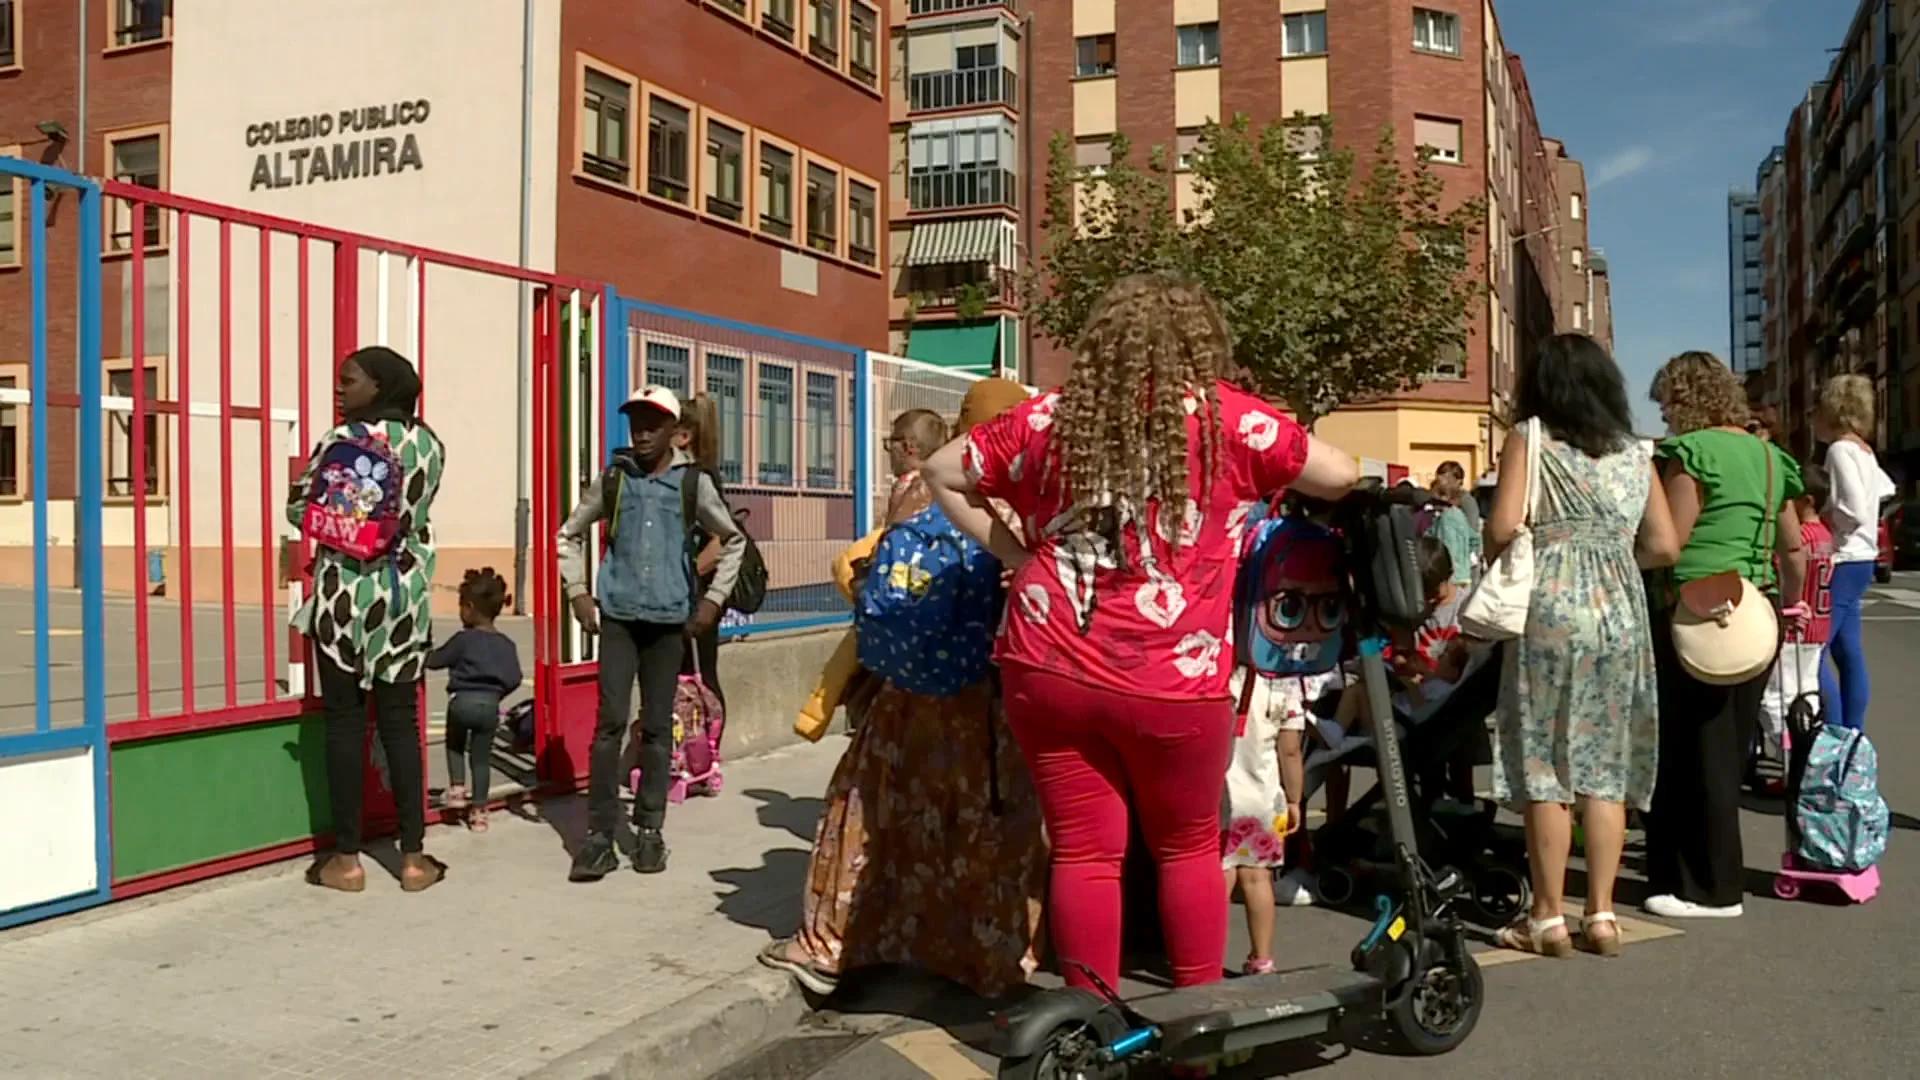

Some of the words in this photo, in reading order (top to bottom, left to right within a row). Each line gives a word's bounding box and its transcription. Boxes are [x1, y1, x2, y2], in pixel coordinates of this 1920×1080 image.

[246, 113, 333, 147] COLEGIO
[338, 98, 430, 133] PUBLICO
[249, 132, 423, 191] ALTAMIRA
[310, 511, 358, 543] PAW
